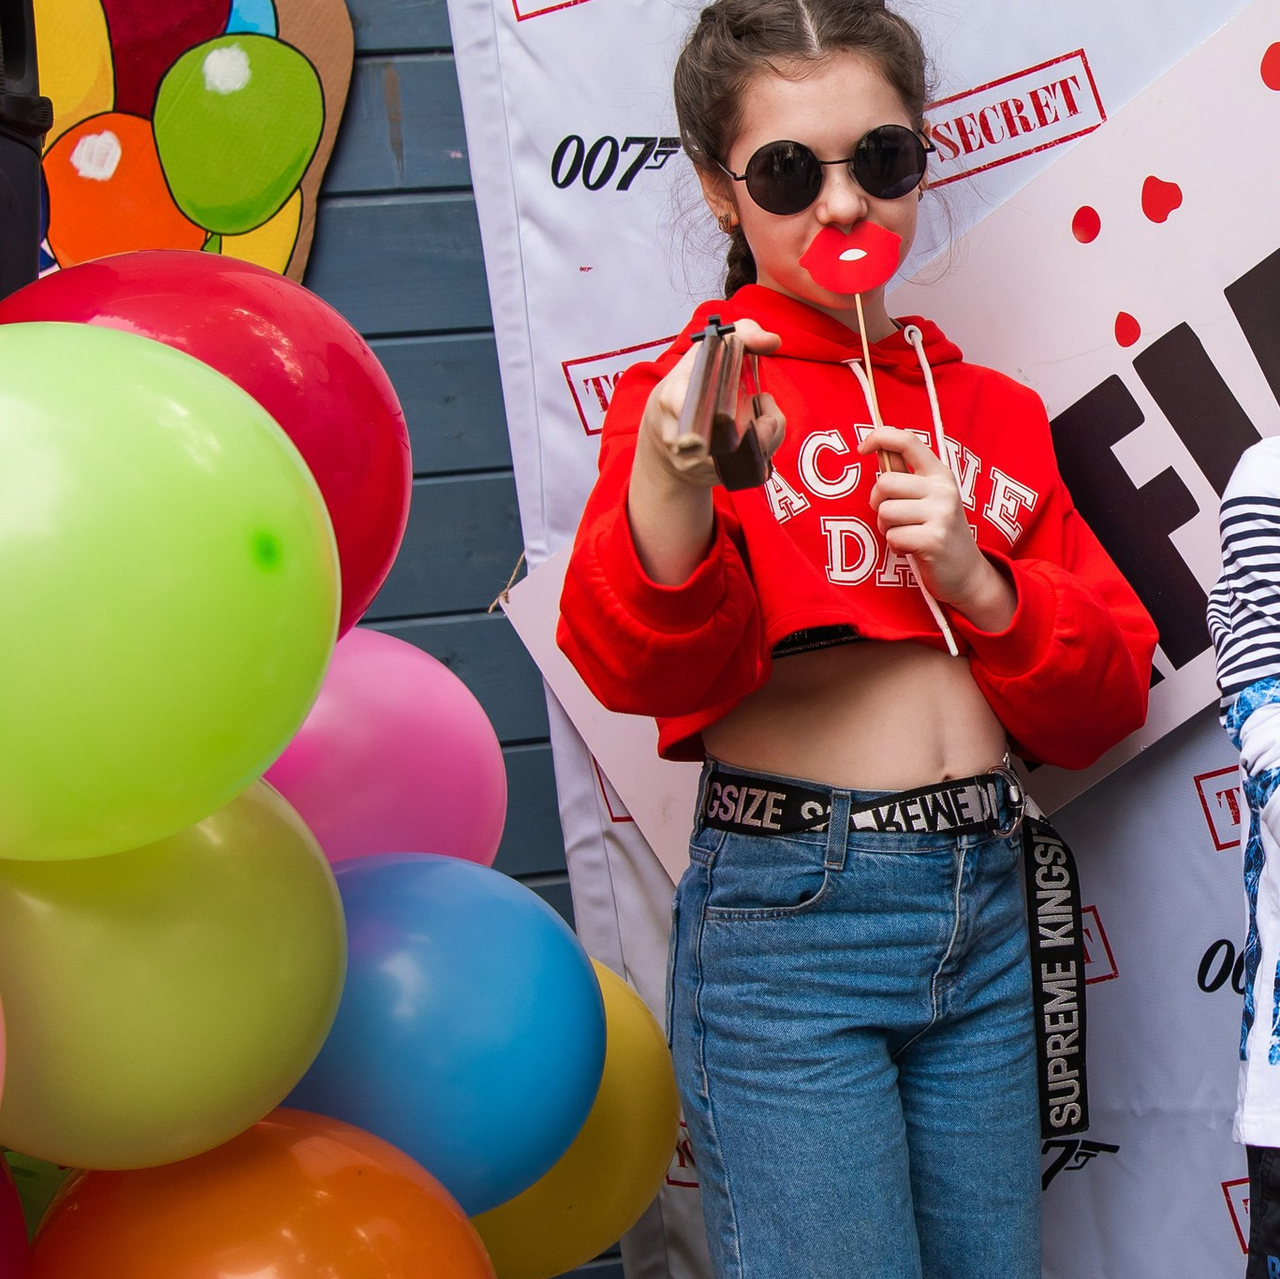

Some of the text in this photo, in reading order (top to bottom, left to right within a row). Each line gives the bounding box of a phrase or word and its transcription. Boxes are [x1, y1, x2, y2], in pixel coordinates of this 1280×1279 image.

[551, 134, 658, 191] 007
[931, 75, 1082, 163] SECRET
[765, 423, 1039, 547] ACVE
[705, 783, 787, 831] GSIZE
[1031, 826, 1075, 949] KINGSI
[1041, 960, 1083, 1129] SUPREME
